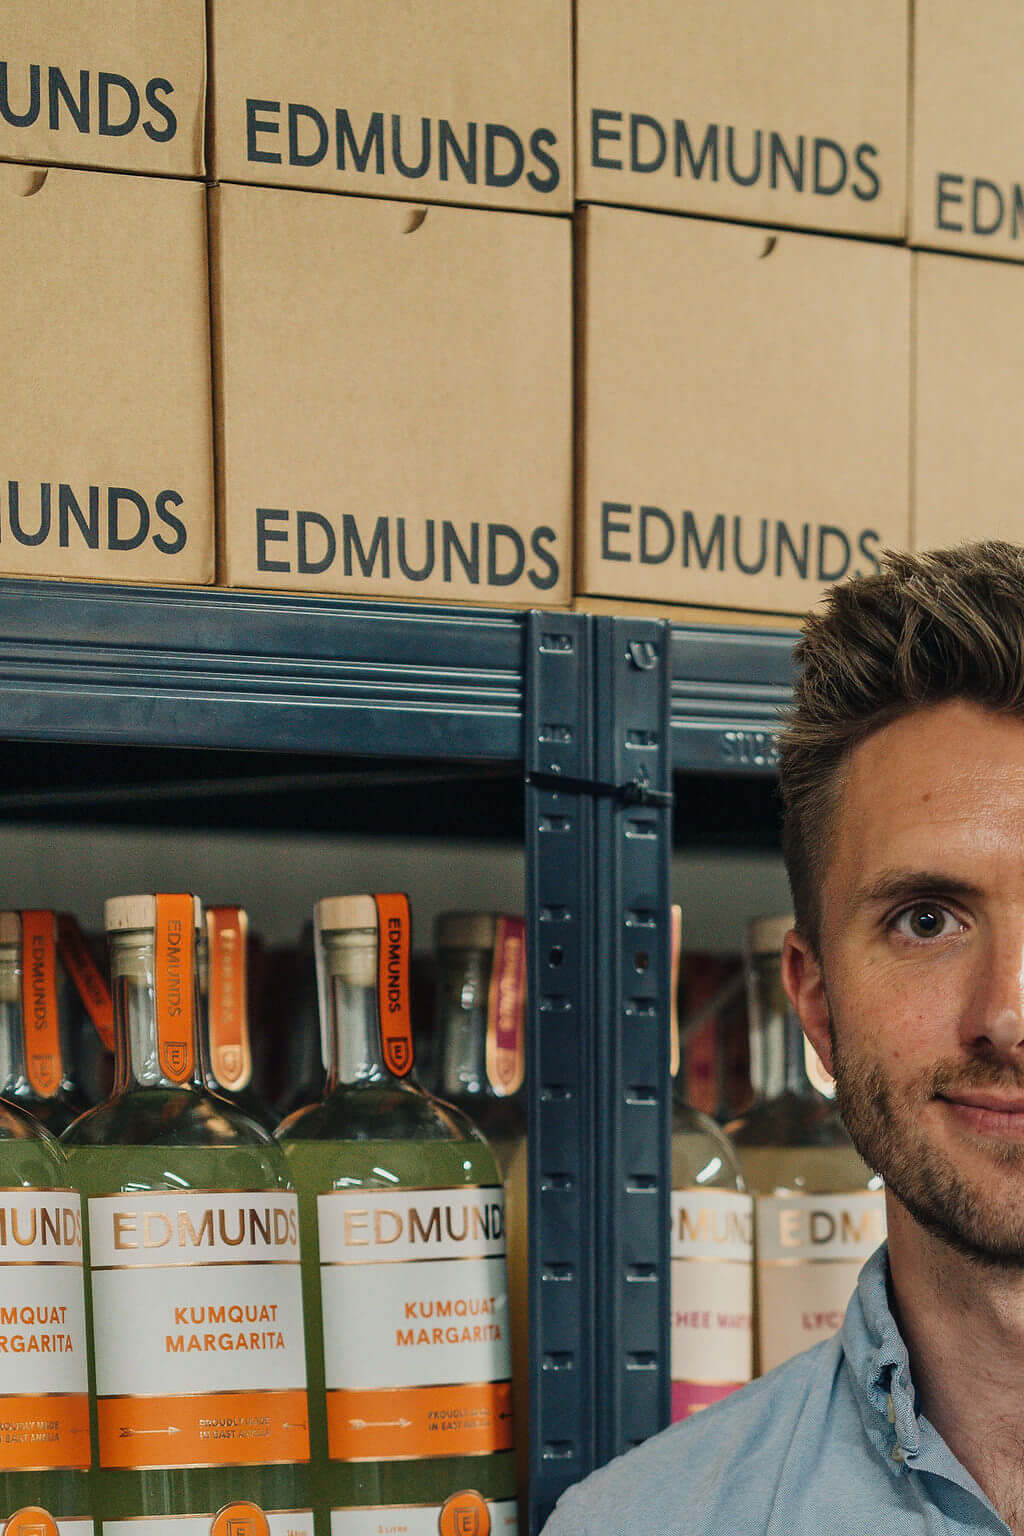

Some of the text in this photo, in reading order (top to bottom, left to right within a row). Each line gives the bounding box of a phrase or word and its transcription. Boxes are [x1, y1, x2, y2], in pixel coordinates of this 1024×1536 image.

[245, 98, 561, 194] EDMUNDS
[590, 107, 881, 202] EDMUNDS
[255, 507, 560, 591] EDMUNDS
[600, 501, 881, 584] EDMUNDS
[32, 935, 48, 1032] EDMUNDS
[167, 920, 182, 1018] EDMUNDS
[388, 918, 402, 1014] EDMUNDS
[113, 1207, 298, 1250] EDMUNDS
[343, 1203, 505, 1247] EDMUND
[165, 1331, 286, 1353] MARGARITA
[174, 1304, 278, 1325] KUMQUAT
[395, 1323, 503, 1347] MARGARITA
[404, 1296, 496, 1320] KUMQUAT
